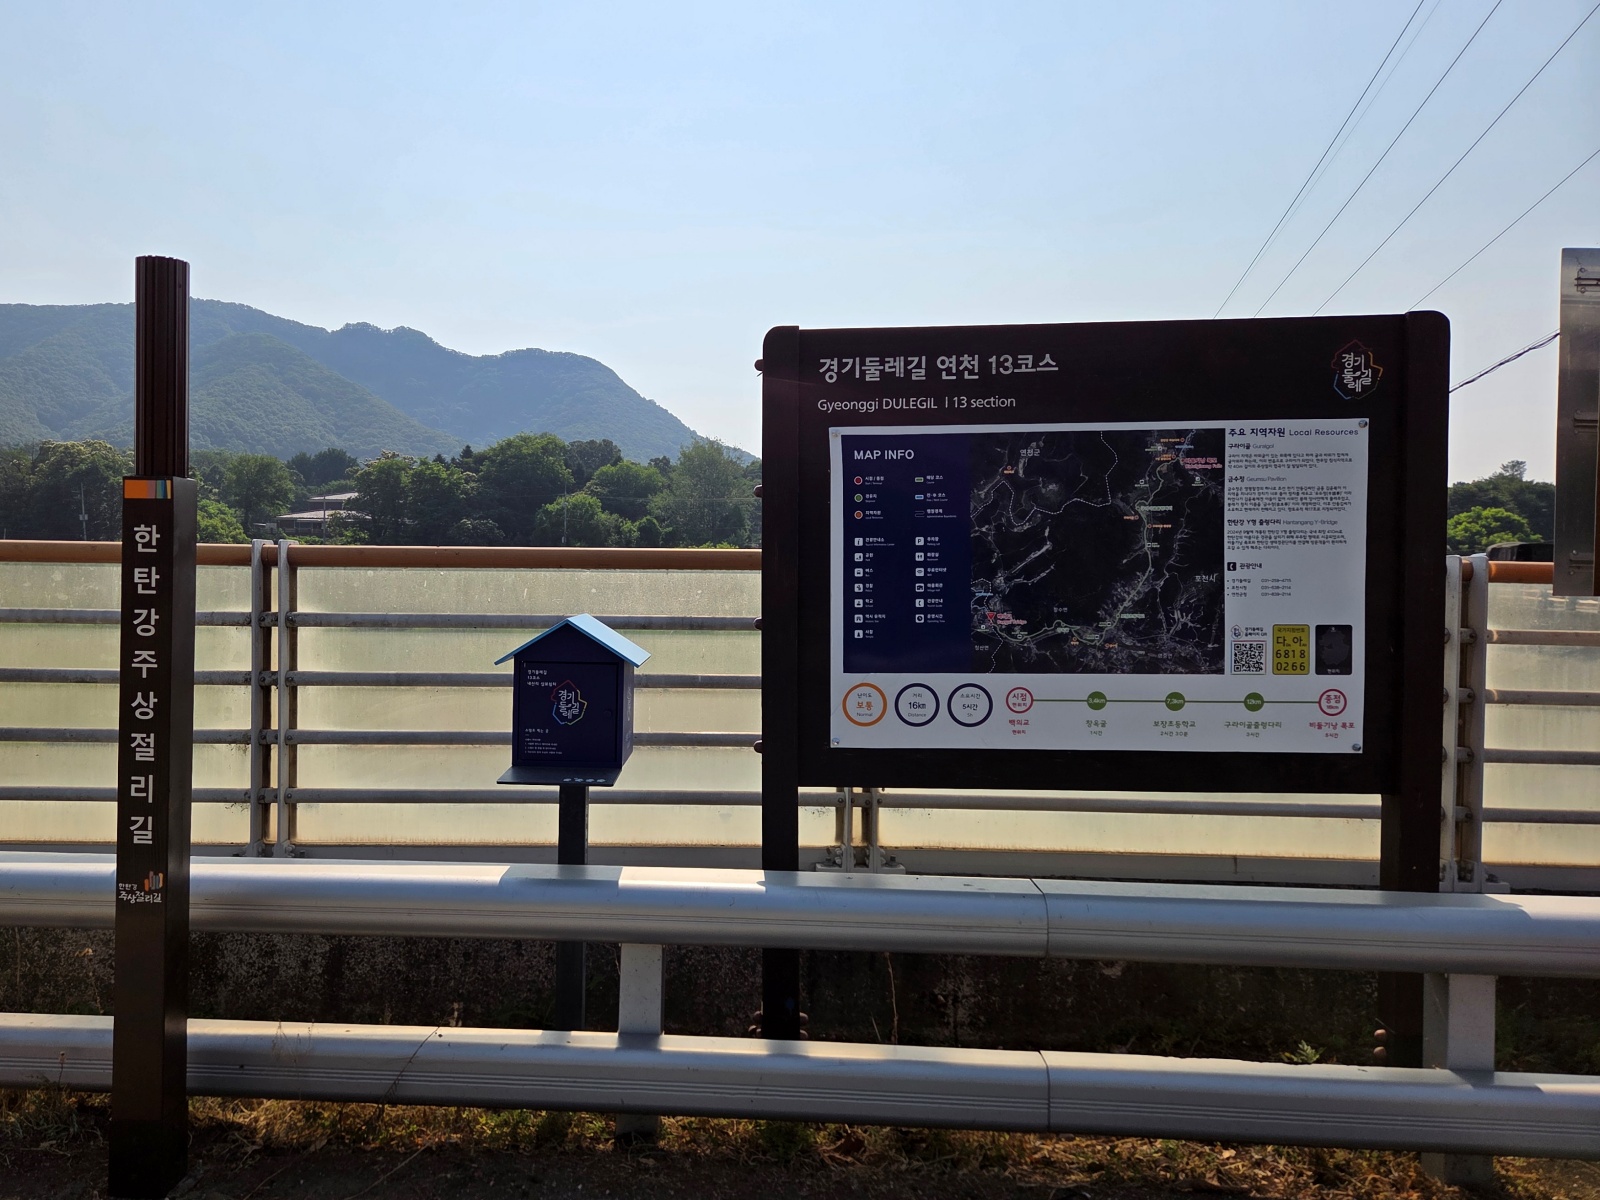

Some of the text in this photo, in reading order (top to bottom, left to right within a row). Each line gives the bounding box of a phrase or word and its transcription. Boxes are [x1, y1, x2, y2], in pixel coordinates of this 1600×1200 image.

[818, 353, 1059, 383] 경기둘레길 연천 13코스
[818, 397, 879, 414] Gyeonggi
[883, 397, 938, 410] DULEGIL
[953, 396, 967, 408] 13
[970, 396, 1016, 408] section
[1228, 428, 1246, 437] 주요
[1250, 427, 1286, 438] 지역자원
[854, 449, 915, 460] MAP INFO
[1276, 636, 1287, 647] 다
[1292, 636, 1303, 647] 아
[1275, 650, 1306, 659] 6818
[1276, 662, 1306, 671] 0266
[1012, 693, 1027, 702] 시점
[856, 701, 874, 711] 보통
[908, 701, 926, 710] 16km
[962, 703, 978, 711] 5시간
[1009, 719, 1030, 727] 백의교
[1309, 722, 1338, 730] 비둘기낭
[118, 891, 162, 904] 주상절리길
